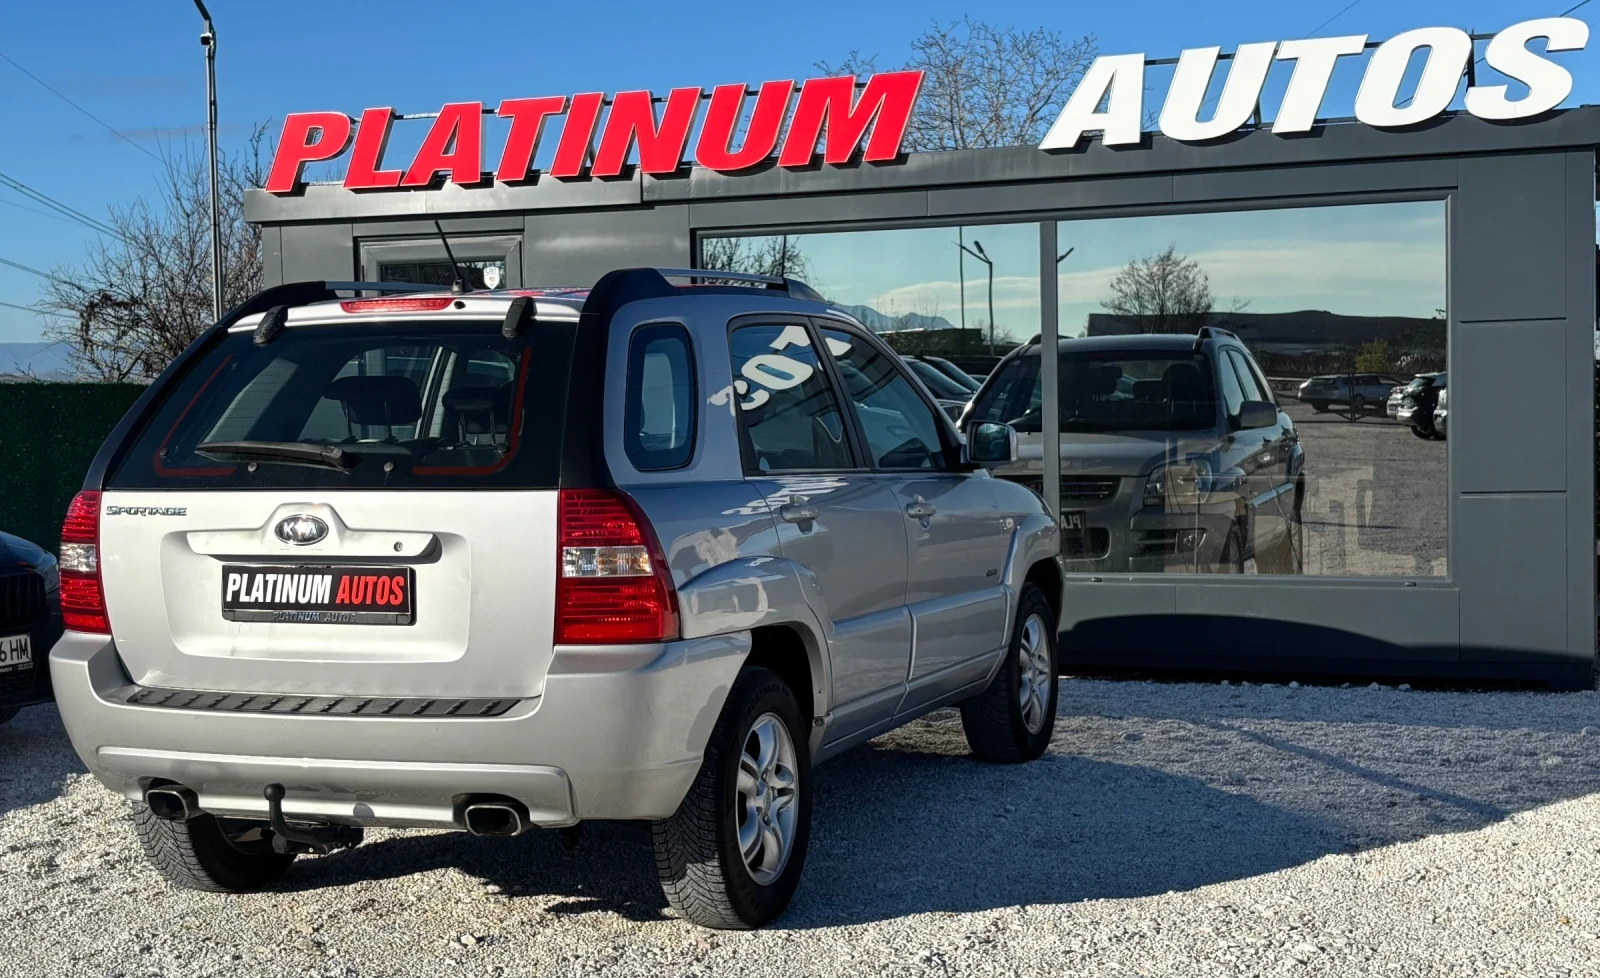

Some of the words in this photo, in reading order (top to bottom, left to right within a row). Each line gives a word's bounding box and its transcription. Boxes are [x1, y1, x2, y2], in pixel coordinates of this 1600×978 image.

[265, 70, 924, 193] PLATINUM
[1038, 17, 1590, 150] AUTOS
[106, 505, 188, 517] SPORTAGE
[283, 520, 318, 540] KIA
[226, 573, 333, 605] PLATINUM
[335, 575, 405, 606] AUTOS
[273, 611, 320, 622] PLATINUM
